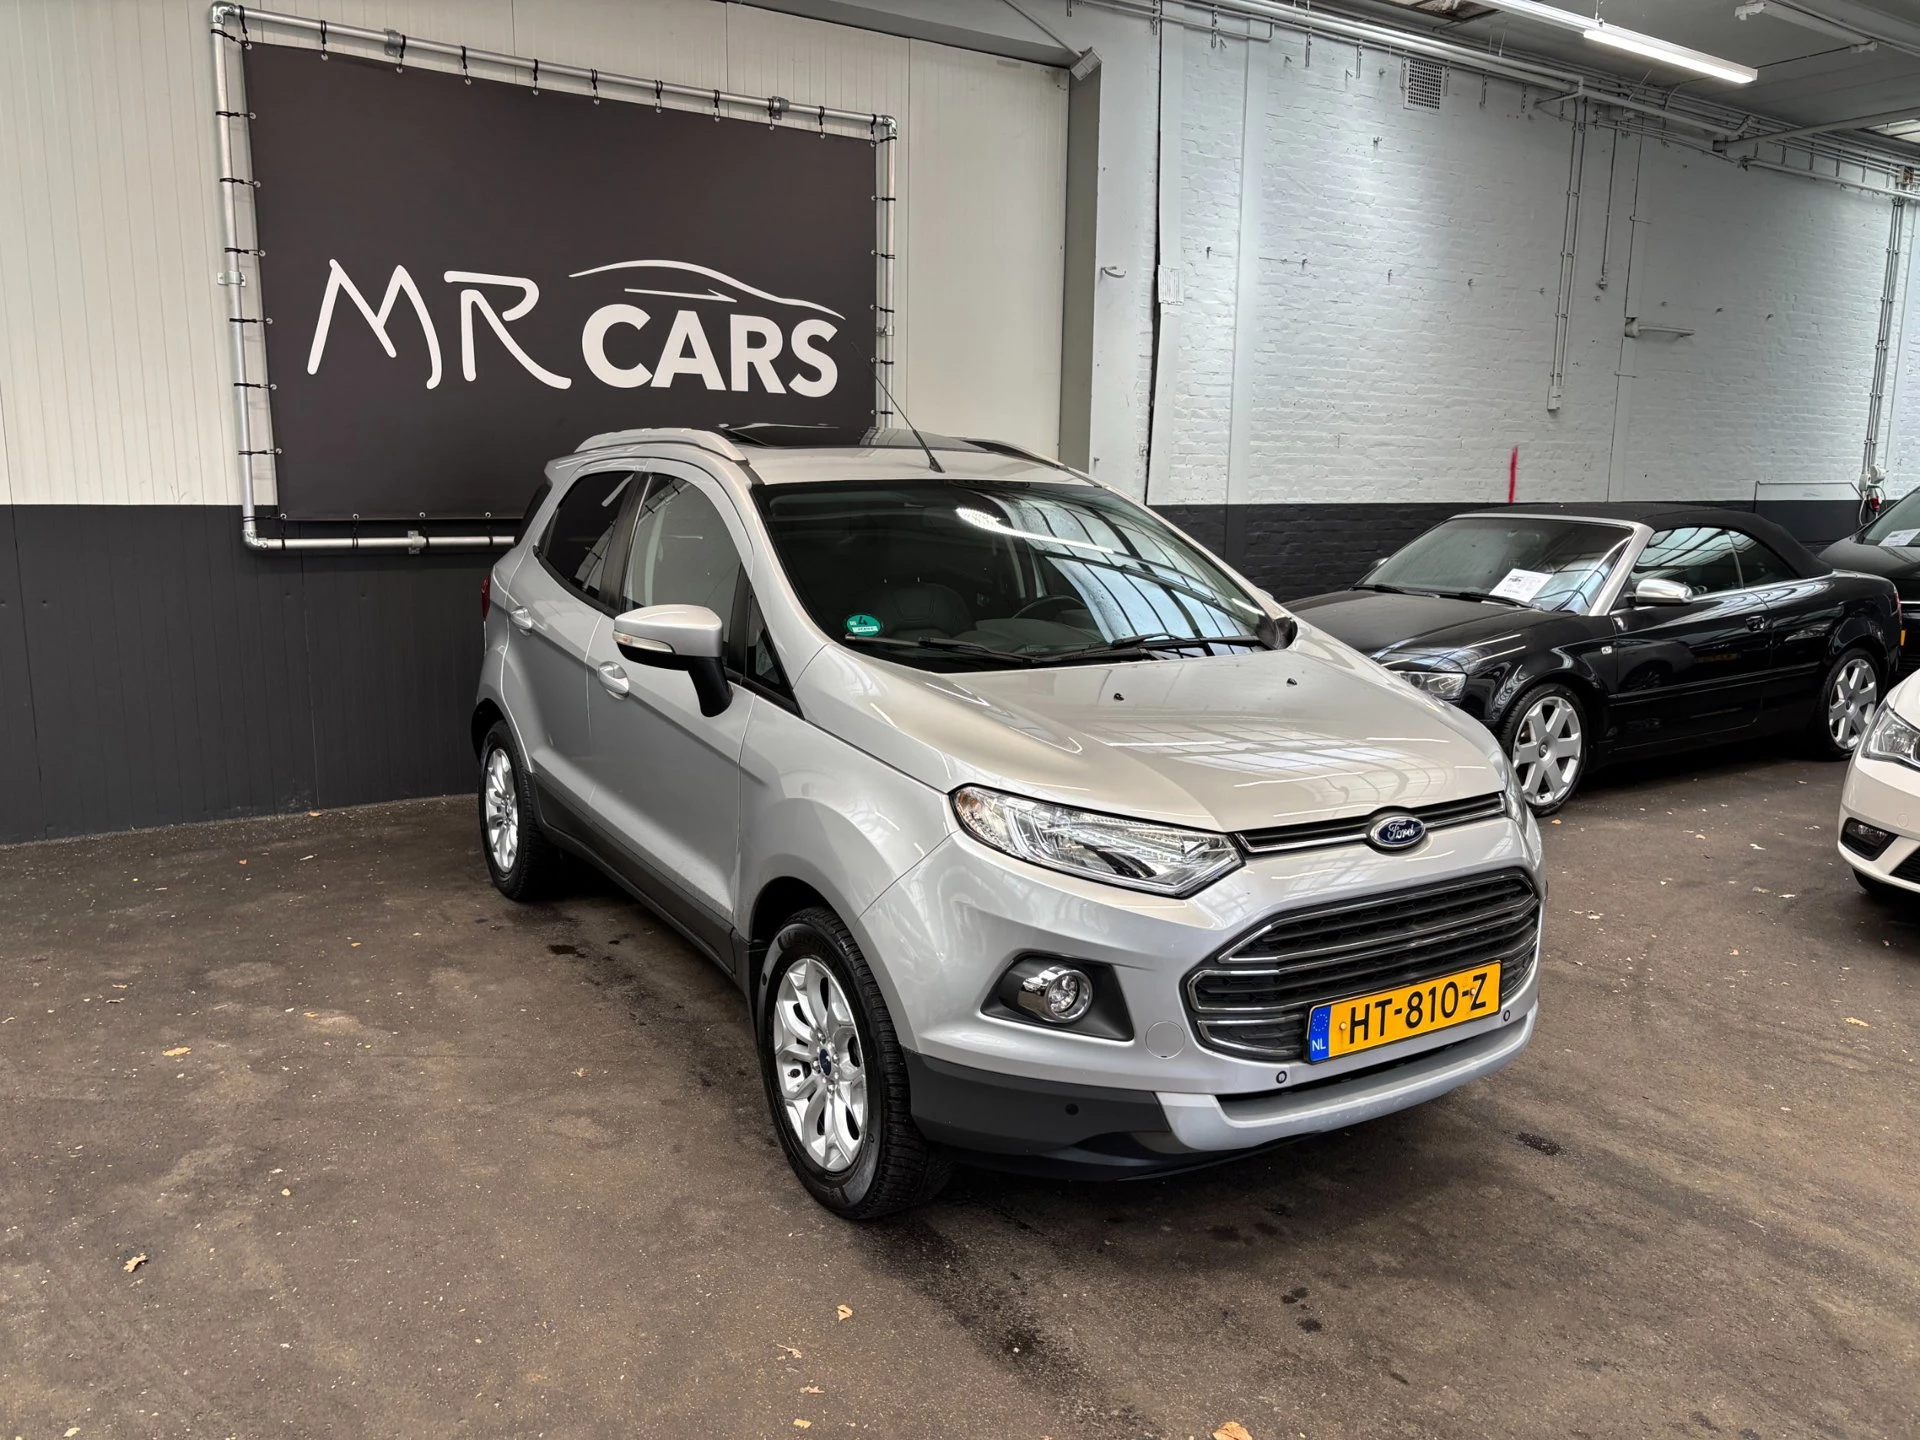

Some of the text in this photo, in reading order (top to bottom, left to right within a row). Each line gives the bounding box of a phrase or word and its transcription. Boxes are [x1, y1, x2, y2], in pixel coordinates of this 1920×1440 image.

[307, 258, 838, 398] MR CARS
[858, 615, 868, 626] 4
[1387, 819, 1416, 841] Ford
[1349, 972, 1488, 1045] HT-810-Z
[1311, 1037, 1326, 1052] NL
